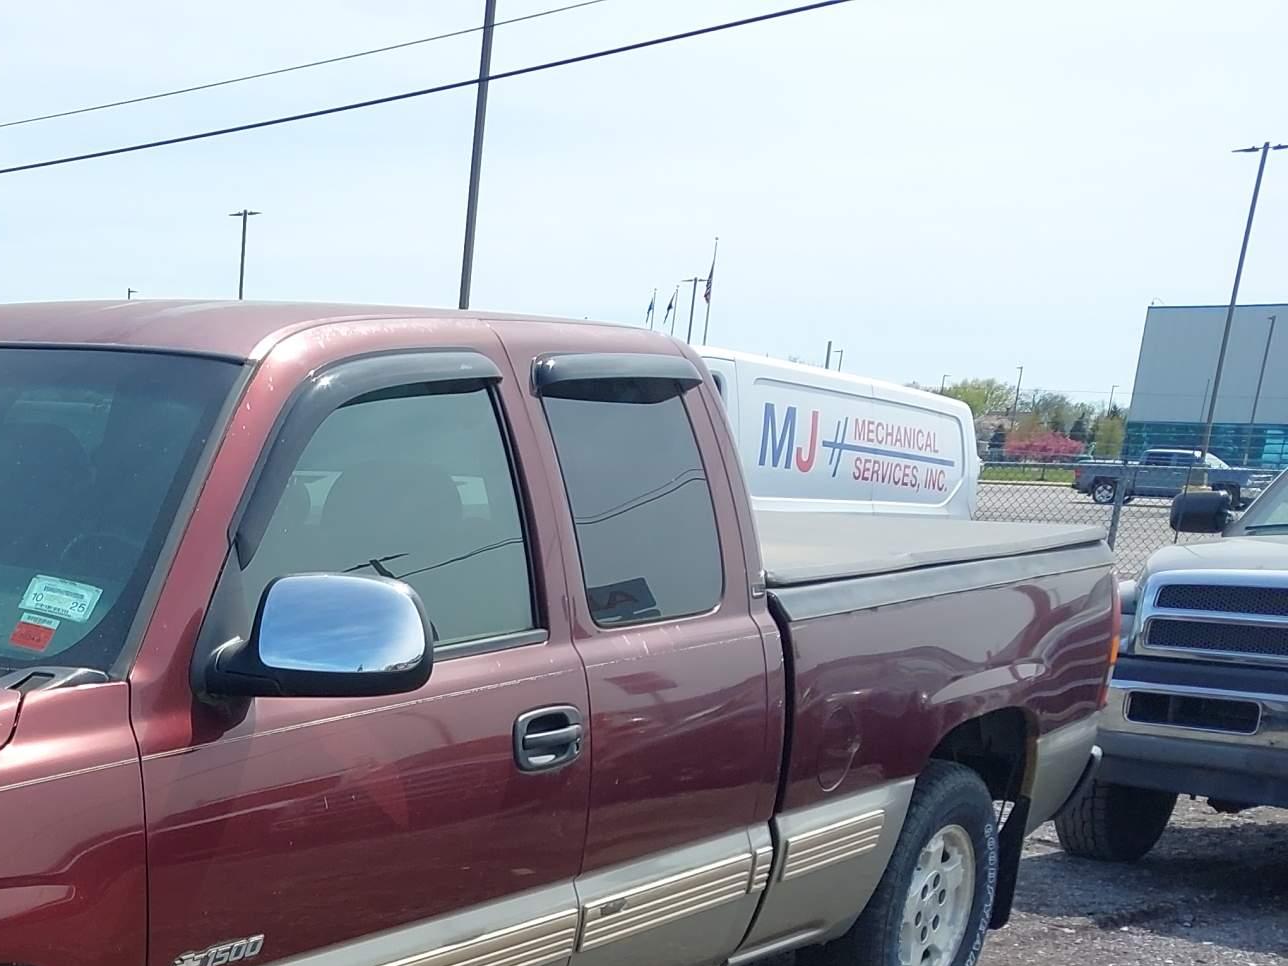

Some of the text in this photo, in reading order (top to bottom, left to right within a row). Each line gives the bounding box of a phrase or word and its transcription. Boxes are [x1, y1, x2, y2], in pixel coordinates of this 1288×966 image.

[758, 402, 819, 473] MJ
[853, 417, 940, 454] MECHANICAL
[852, 456, 948, 493] SERVICES, INC.
[32, 592, 44, 602] 10
